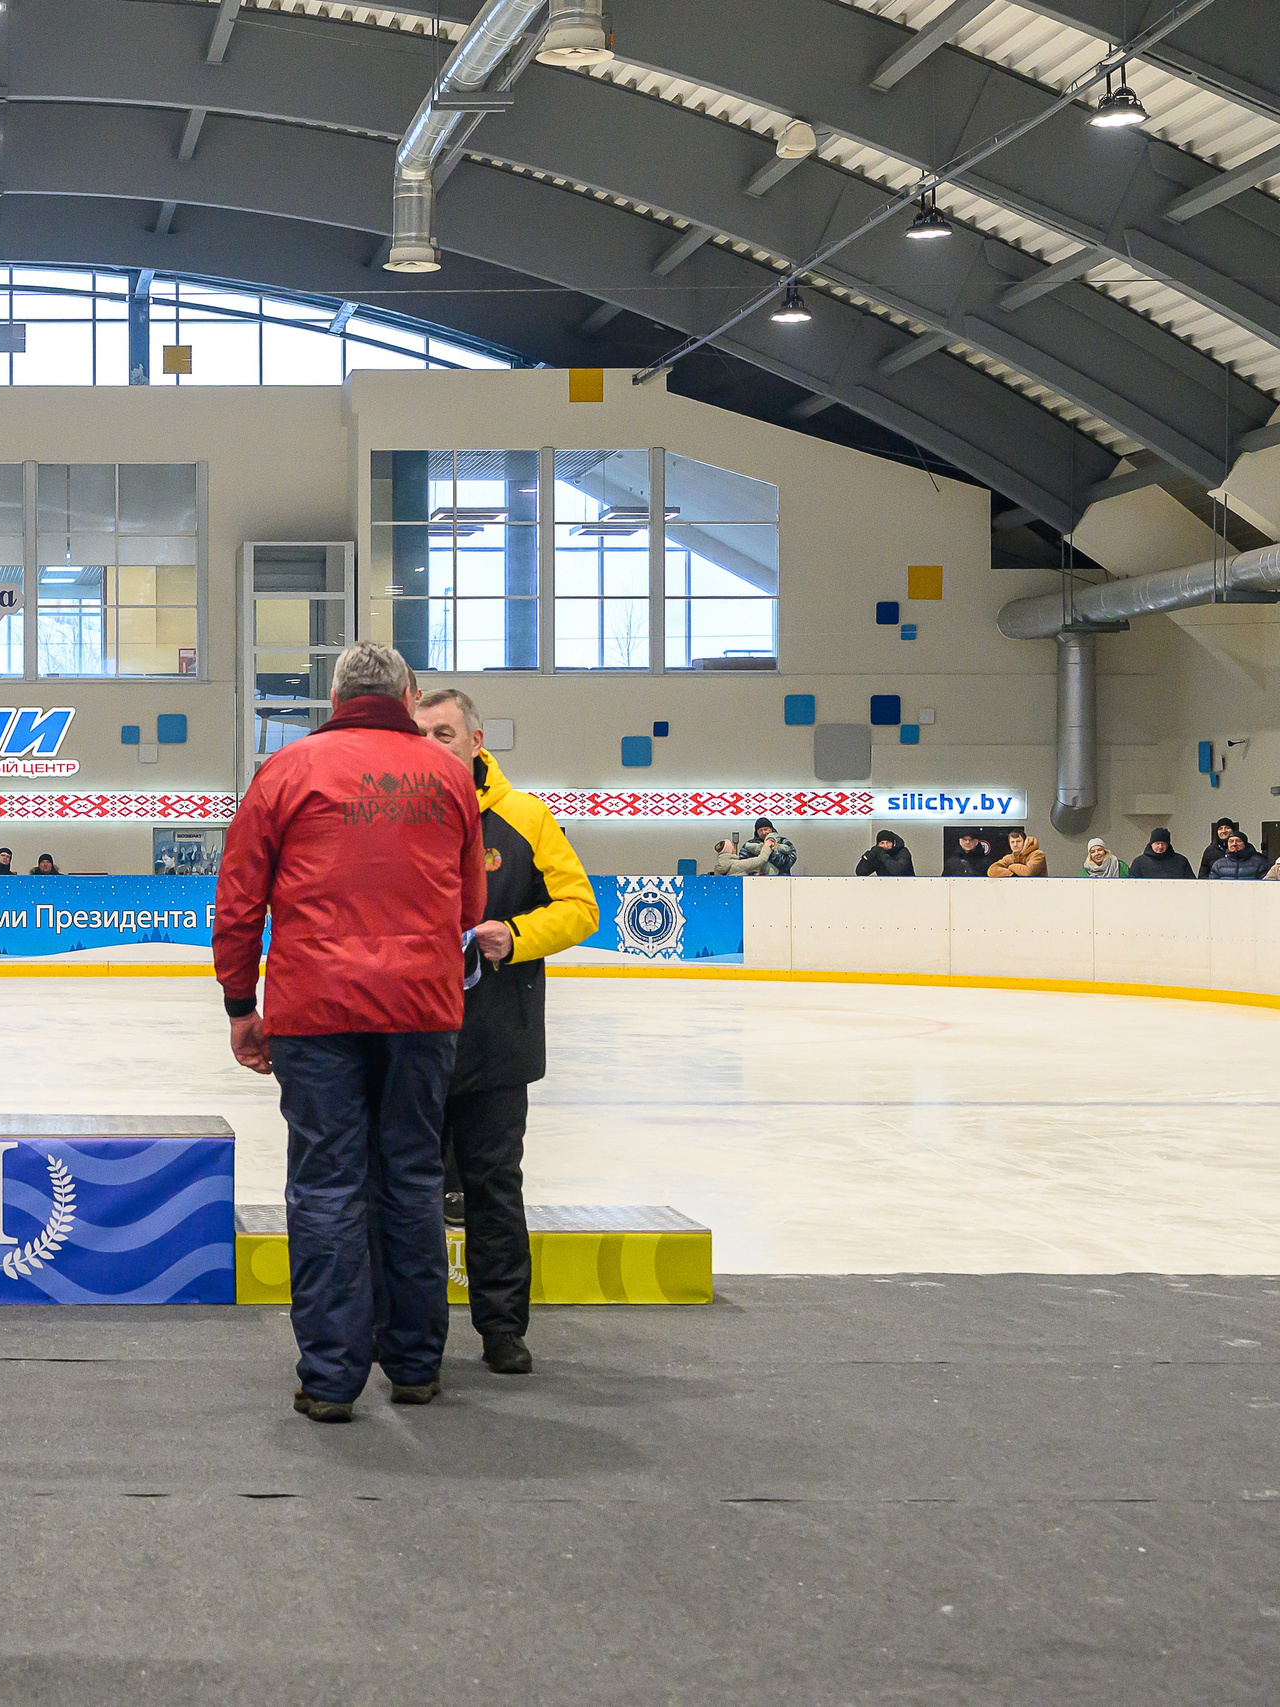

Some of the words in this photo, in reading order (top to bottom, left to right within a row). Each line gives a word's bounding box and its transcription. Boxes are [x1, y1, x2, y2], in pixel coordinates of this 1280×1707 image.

[23, 763, 76, 775] ЦЕНТР
[887, 793, 1013, 815] silichy.by
[35, 904, 197, 934] Президента
